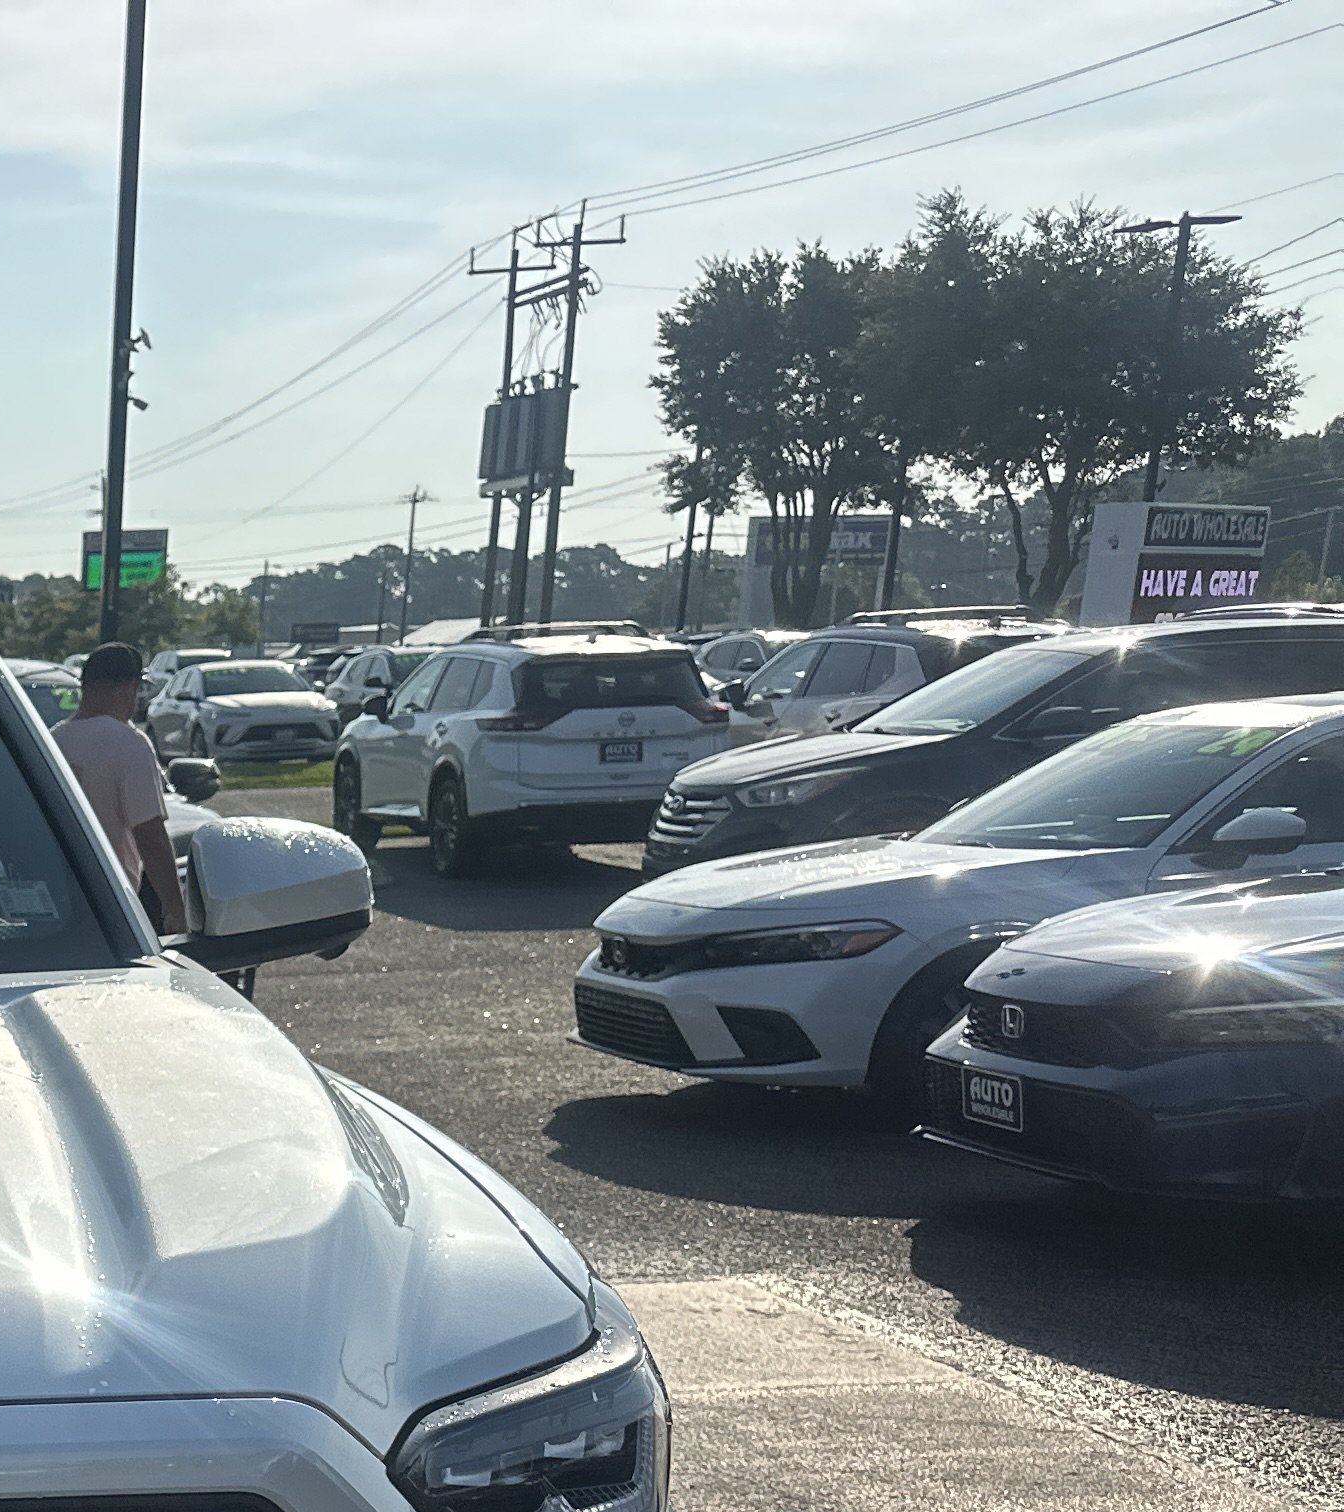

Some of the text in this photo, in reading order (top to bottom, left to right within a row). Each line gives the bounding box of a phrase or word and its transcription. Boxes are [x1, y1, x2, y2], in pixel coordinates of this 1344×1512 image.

[1151, 512, 1266, 543] AUTO WHOLESALE
[1140, 569, 1259, 597] HAVE A GREAT
[970, 1076, 1014, 1107] AUTO
